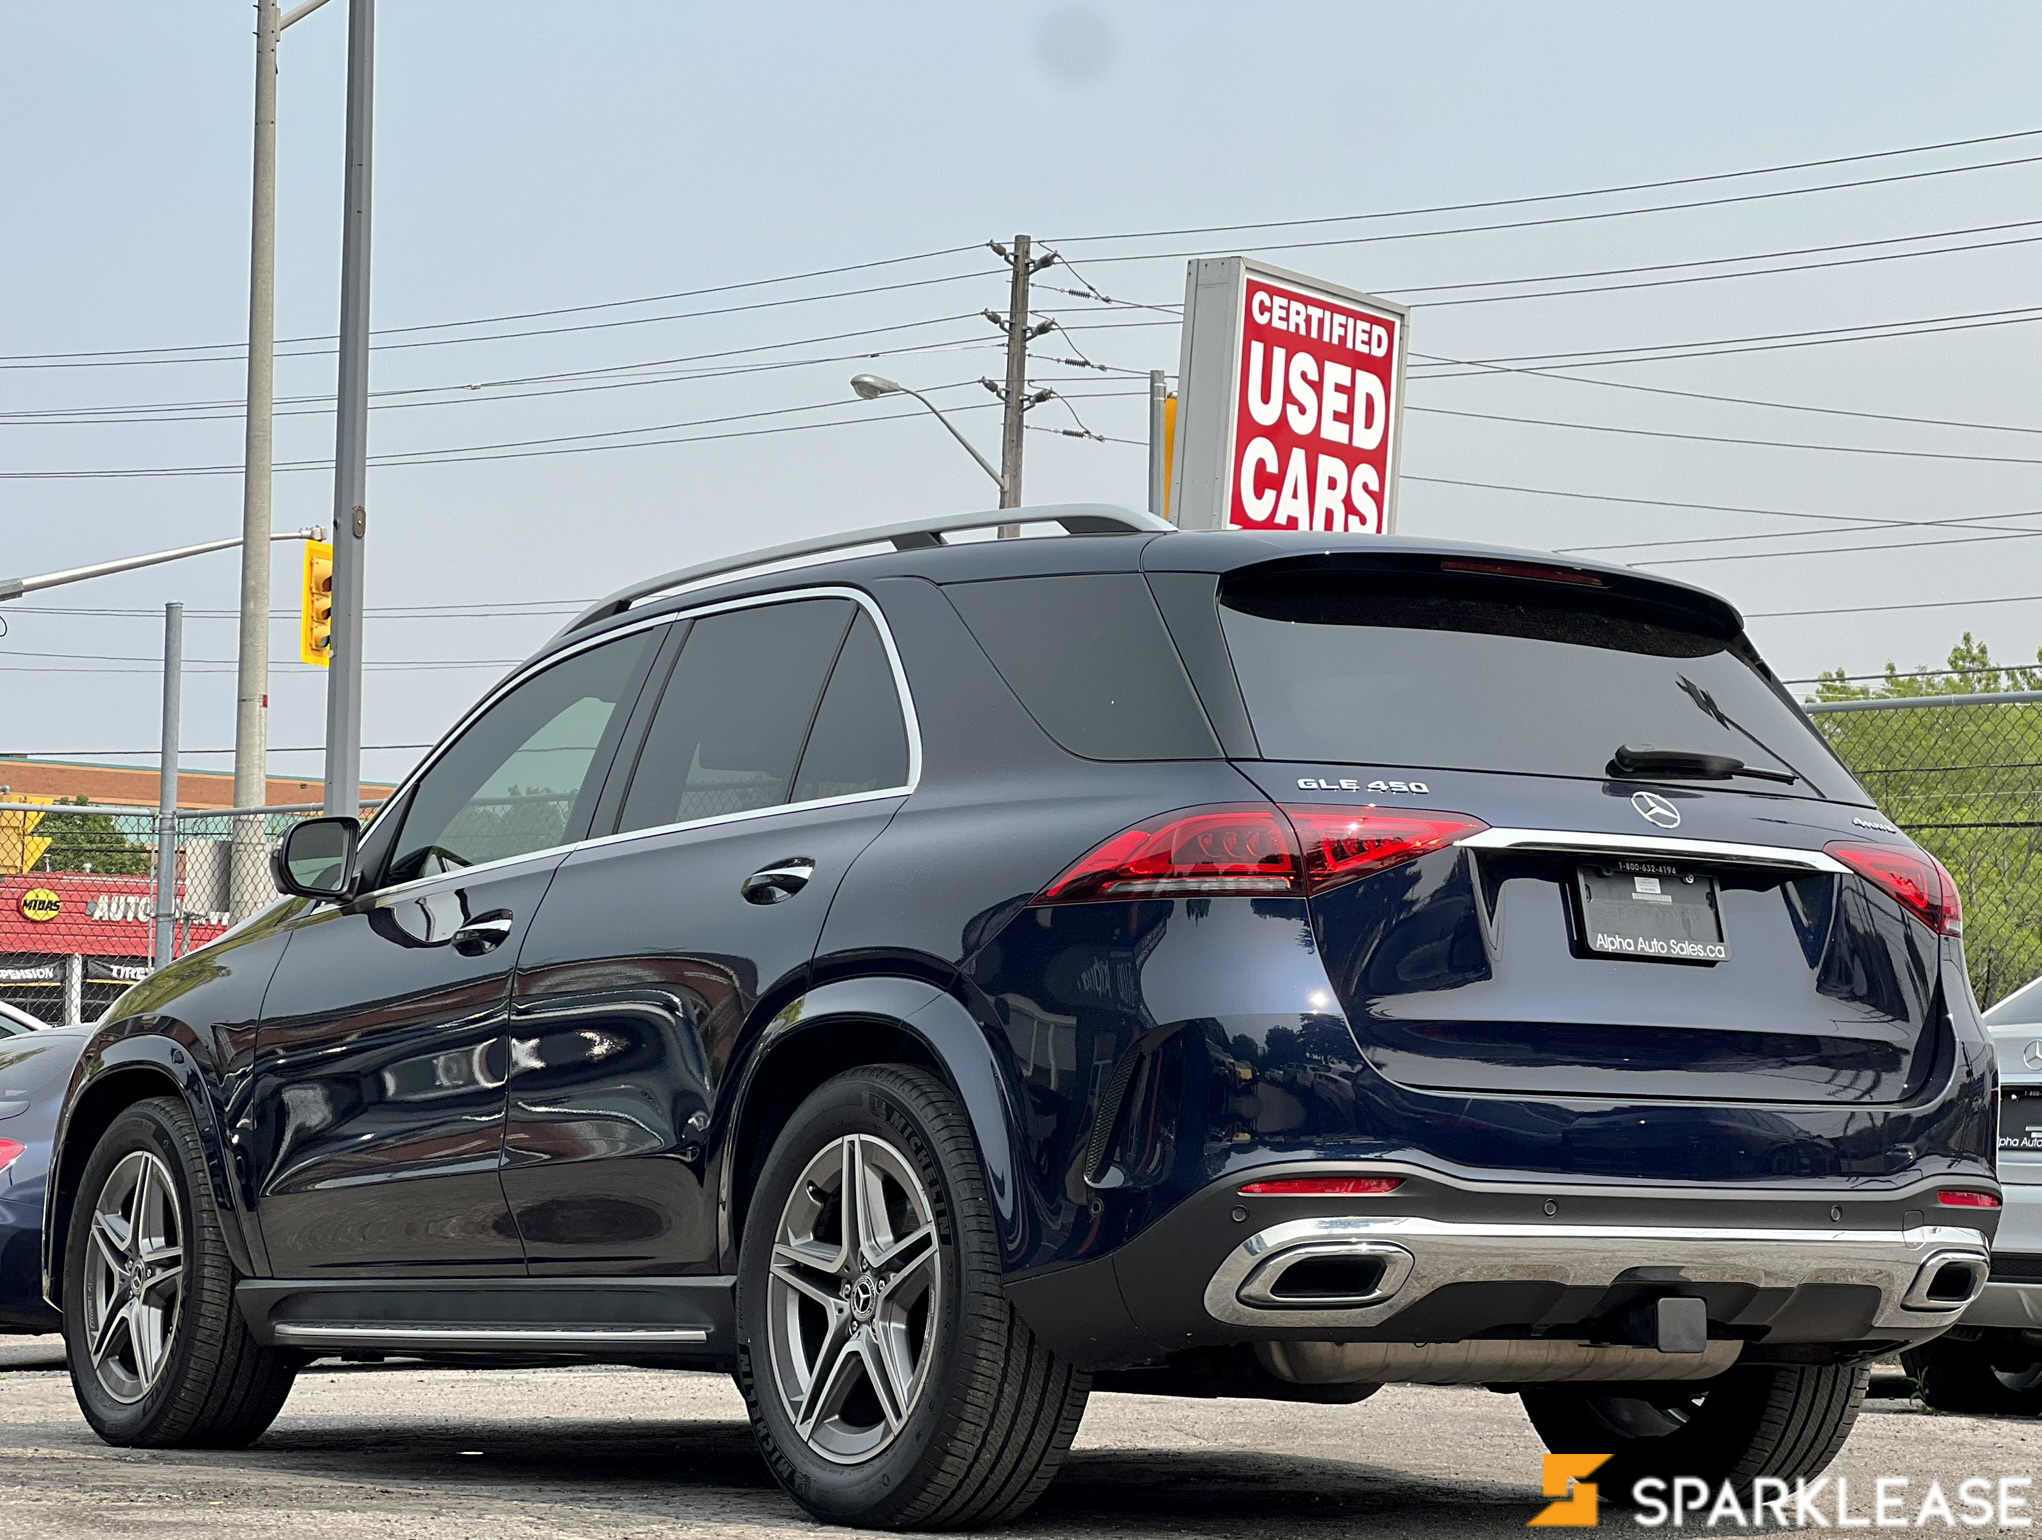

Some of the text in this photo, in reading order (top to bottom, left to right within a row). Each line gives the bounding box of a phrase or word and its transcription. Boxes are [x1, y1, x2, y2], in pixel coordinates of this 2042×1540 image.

[1251, 290, 1389, 358] CERTIFIED
[1247, 340, 1386, 451] USED
[1240, 436, 1380, 534] CARS
[1297, 778, 1430, 794] GLE 450
[23, 899, 60, 911] MIDAS
[1596, 933, 1725, 958] Alpha Auto Sales.ca
[0, 968, 54, 979] PENSION
[888, 1109, 950, 1235] MICHELIN
